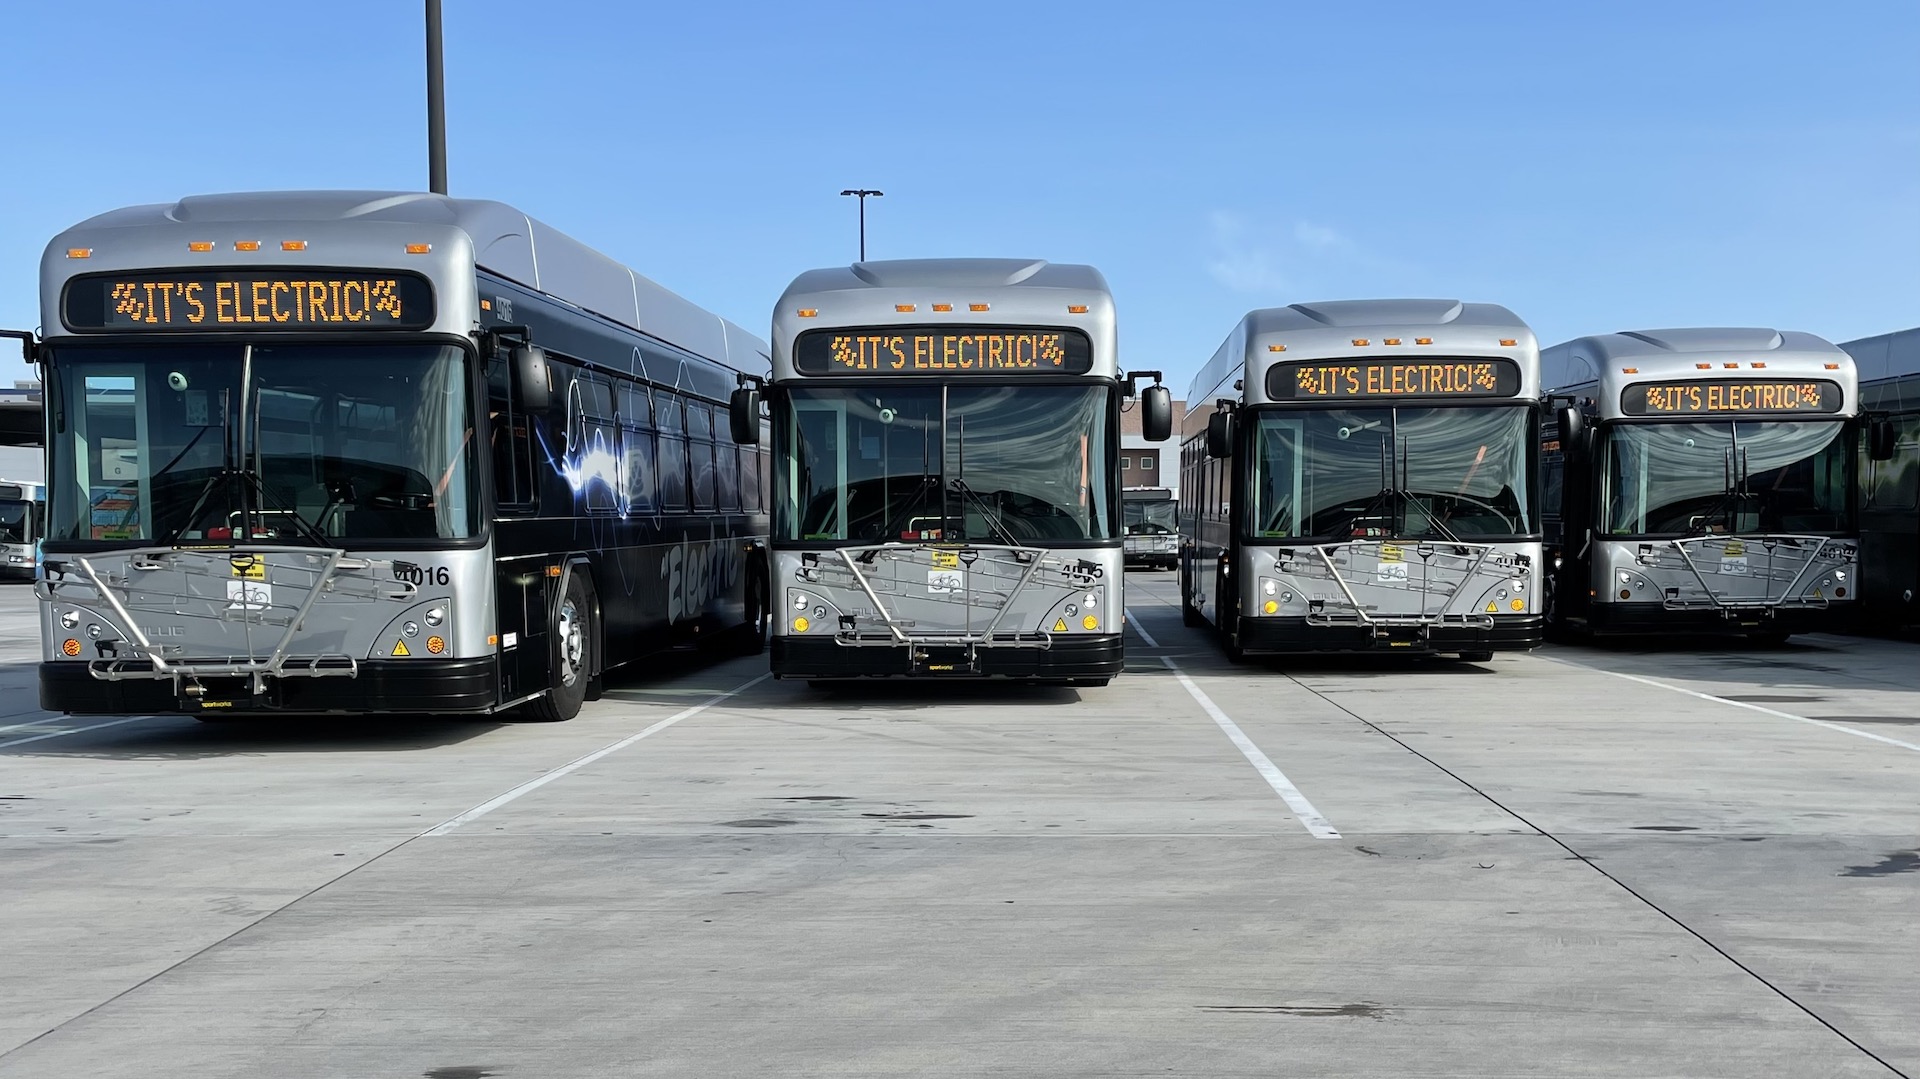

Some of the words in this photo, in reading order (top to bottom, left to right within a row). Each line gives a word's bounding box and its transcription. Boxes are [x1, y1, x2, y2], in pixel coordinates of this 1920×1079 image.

[143, 282, 205, 323] IT'S
[216, 280, 371, 323] ELECTRIC!
[856, 336, 905, 369] IT'S
[914, 335, 1038, 369] ELECTRIC!
[1318, 366, 1360, 394] IT'S
[1367, 364, 1473, 394] ELECTRIC!
[1665, 386, 1701, 411] IT'S
[1707, 384, 1800, 410] ELECTRIC!
[1061, 564, 1103, 579] 405
